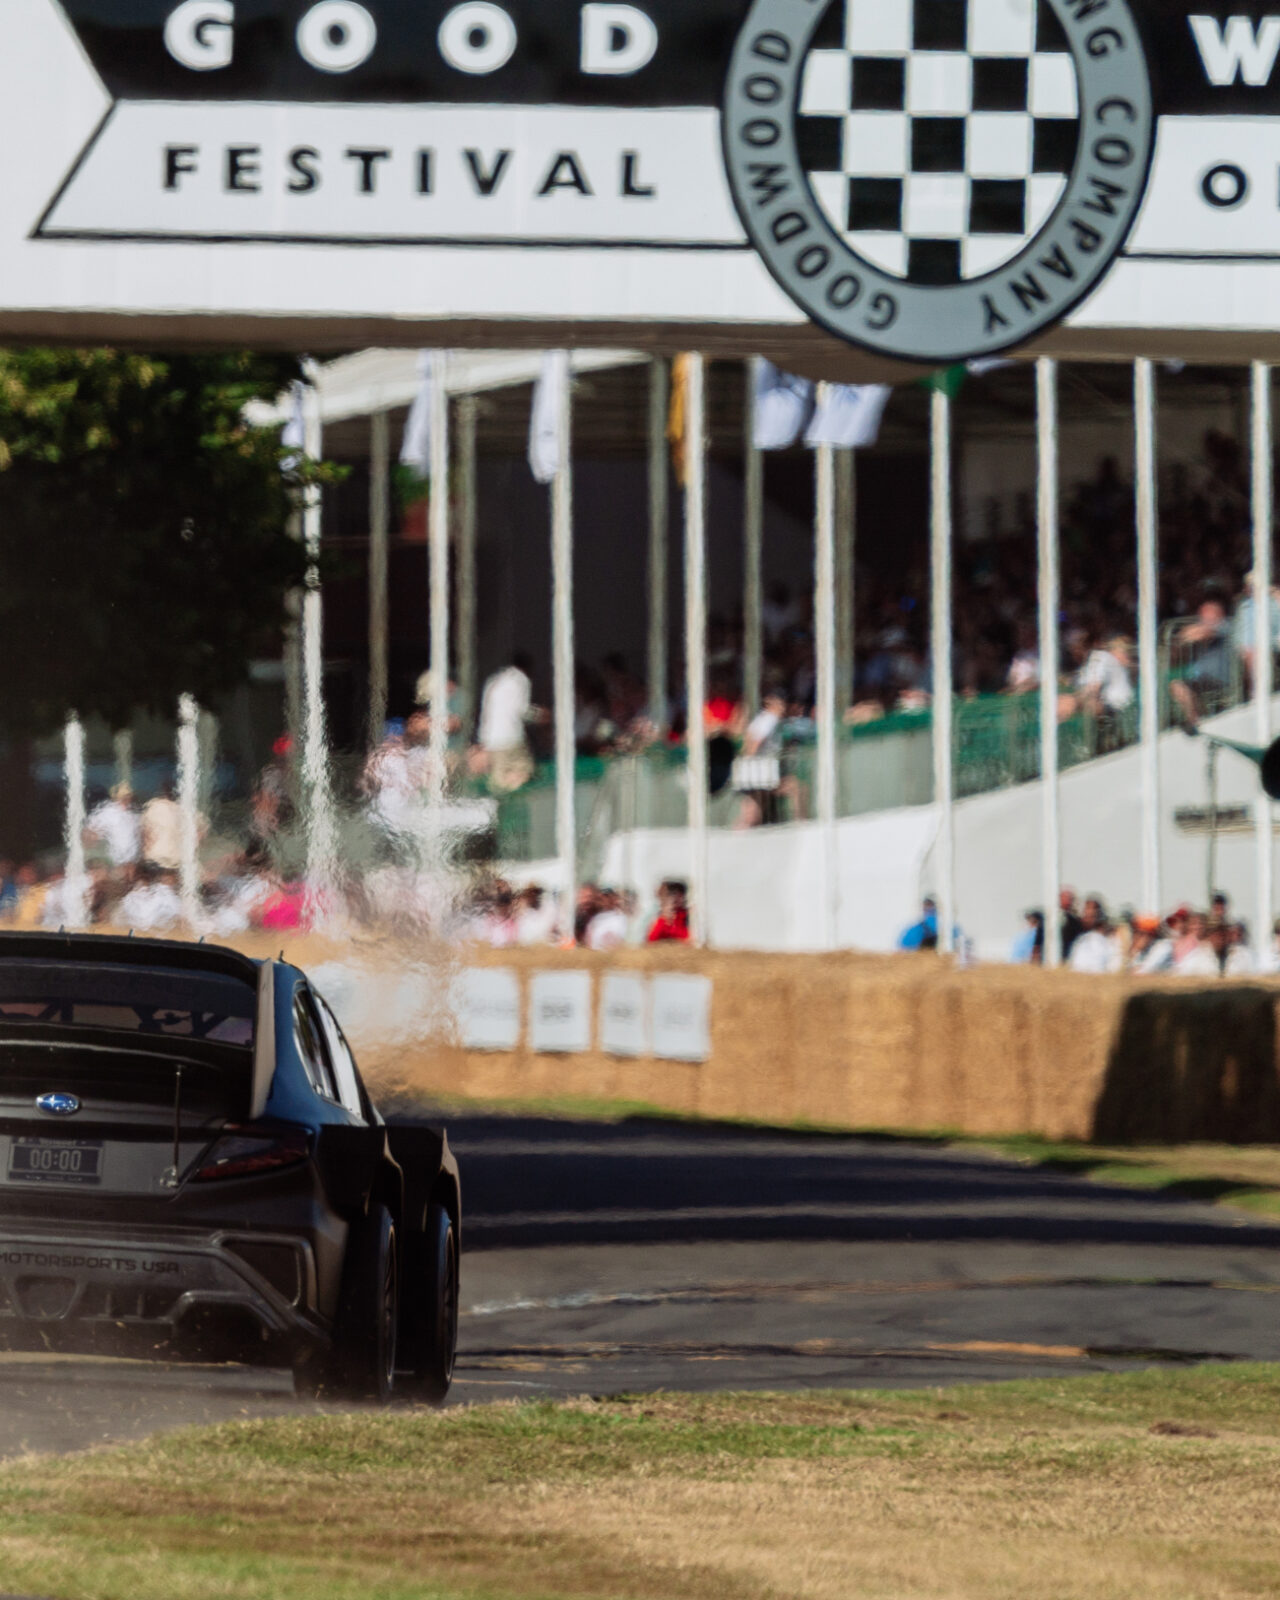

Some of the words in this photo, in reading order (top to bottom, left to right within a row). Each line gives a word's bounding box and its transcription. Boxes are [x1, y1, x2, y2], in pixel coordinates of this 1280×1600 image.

[163, 0, 659, 76] GOOD
[163, 144, 656, 197] FESTIVAL
[742, 30, 899, 331] GOODWOOD
[980, 97, 1136, 333] COMPANY
[31, 1149, 81, 1171] 00:00
[142, 1261, 180, 1273] USA
